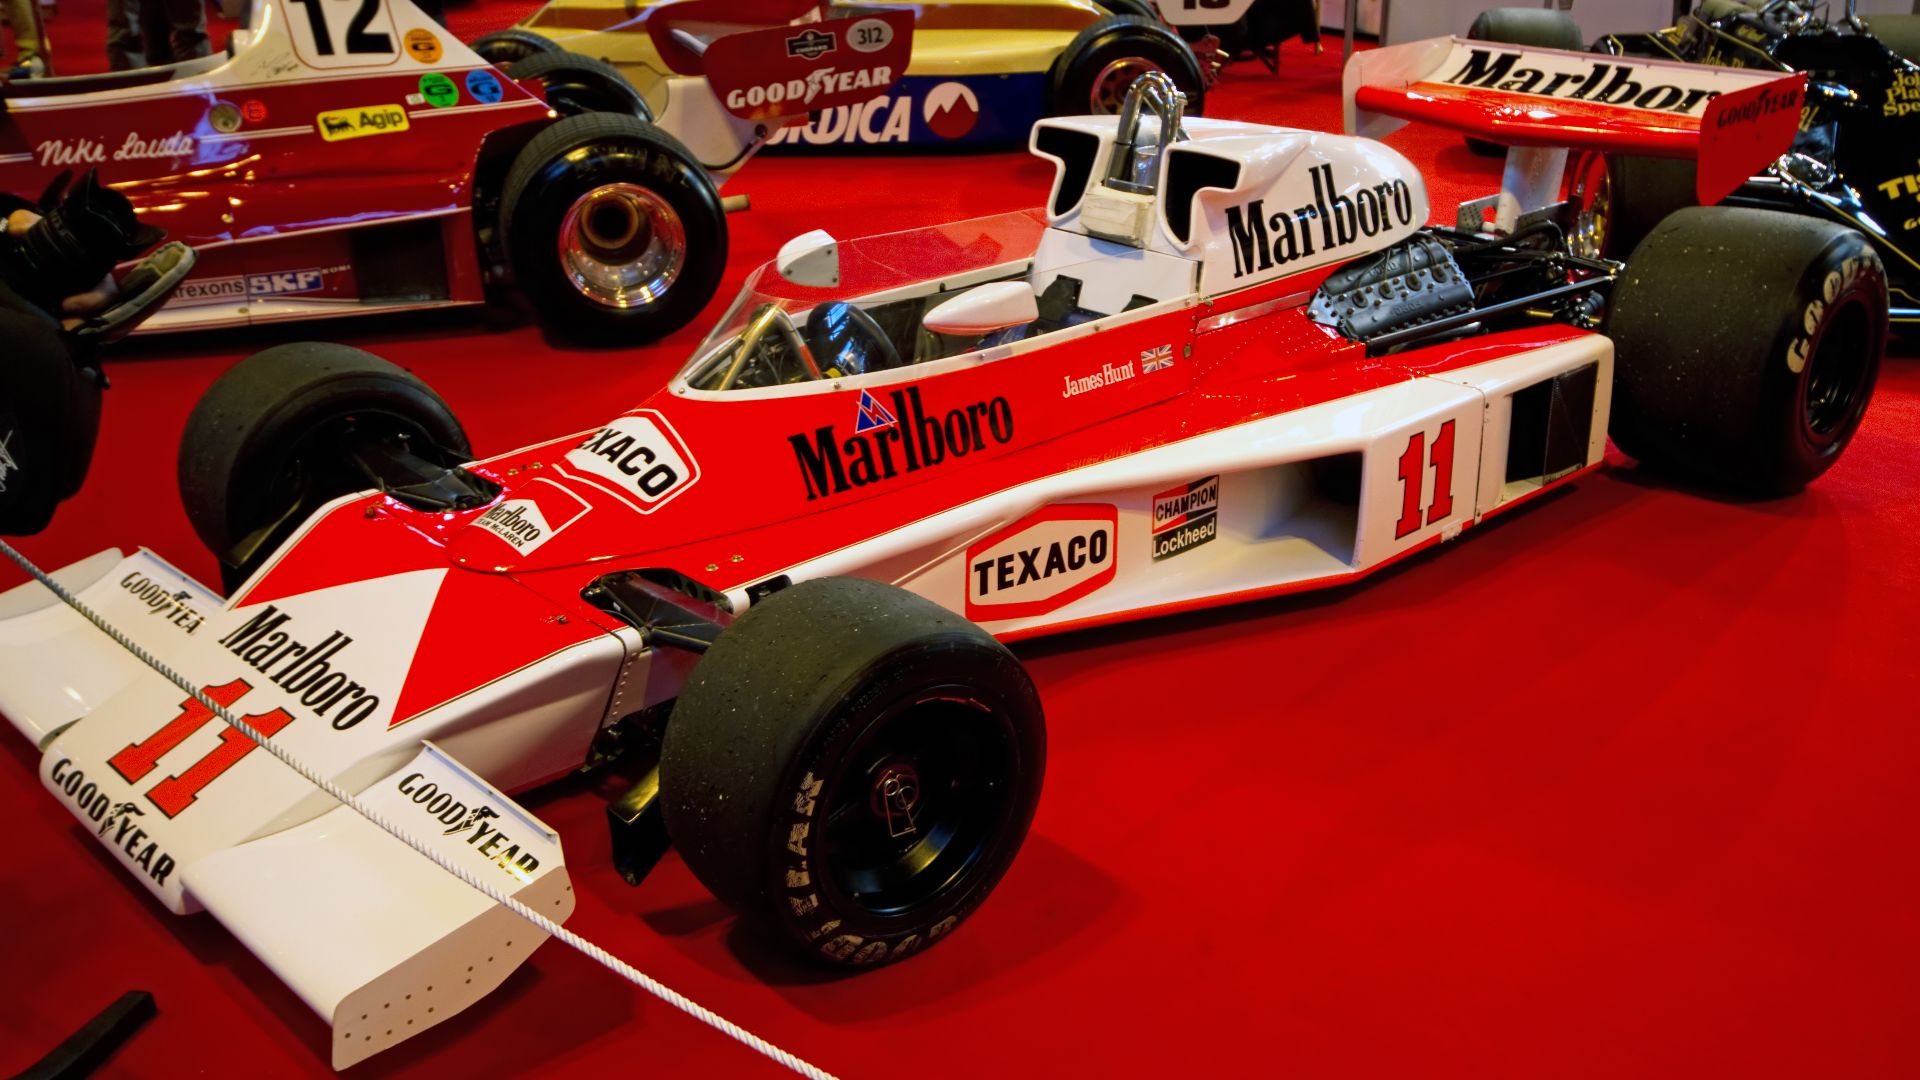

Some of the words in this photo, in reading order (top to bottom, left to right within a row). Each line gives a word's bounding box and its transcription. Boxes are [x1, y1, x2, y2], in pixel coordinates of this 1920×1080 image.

[289, 0, 395, 56] 12
[856, 26, 884, 45] 312
[1443, 49, 1722, 114] Marlbor
[37, 136, 107, 166] Niki
[113, 131, 194, 161] Lauda
[359, 111, 404, 129] Agip
[1225, 163, 1412, 278] Marlboro
[172, 279, 244, 299] rexons
[250, 270, 321, 294] SKF
[1062, 375, 1104, 398] James
[1102, 360, 1136, 386] Hunt
[787, 386, 1015, 501] Marlboro
[1155, 484, 1217, 522] CHAMPION
[1394, 418, 1456, 541] 11
[973, 528, 1109, 597] TEXACO
[1153, 516, 1216, 558] Lockheed
[218, 605, 380, 731] Marlboro
[106, 677, 297, 820] 11
[51, 758, 176, 887] GOODYEAR
